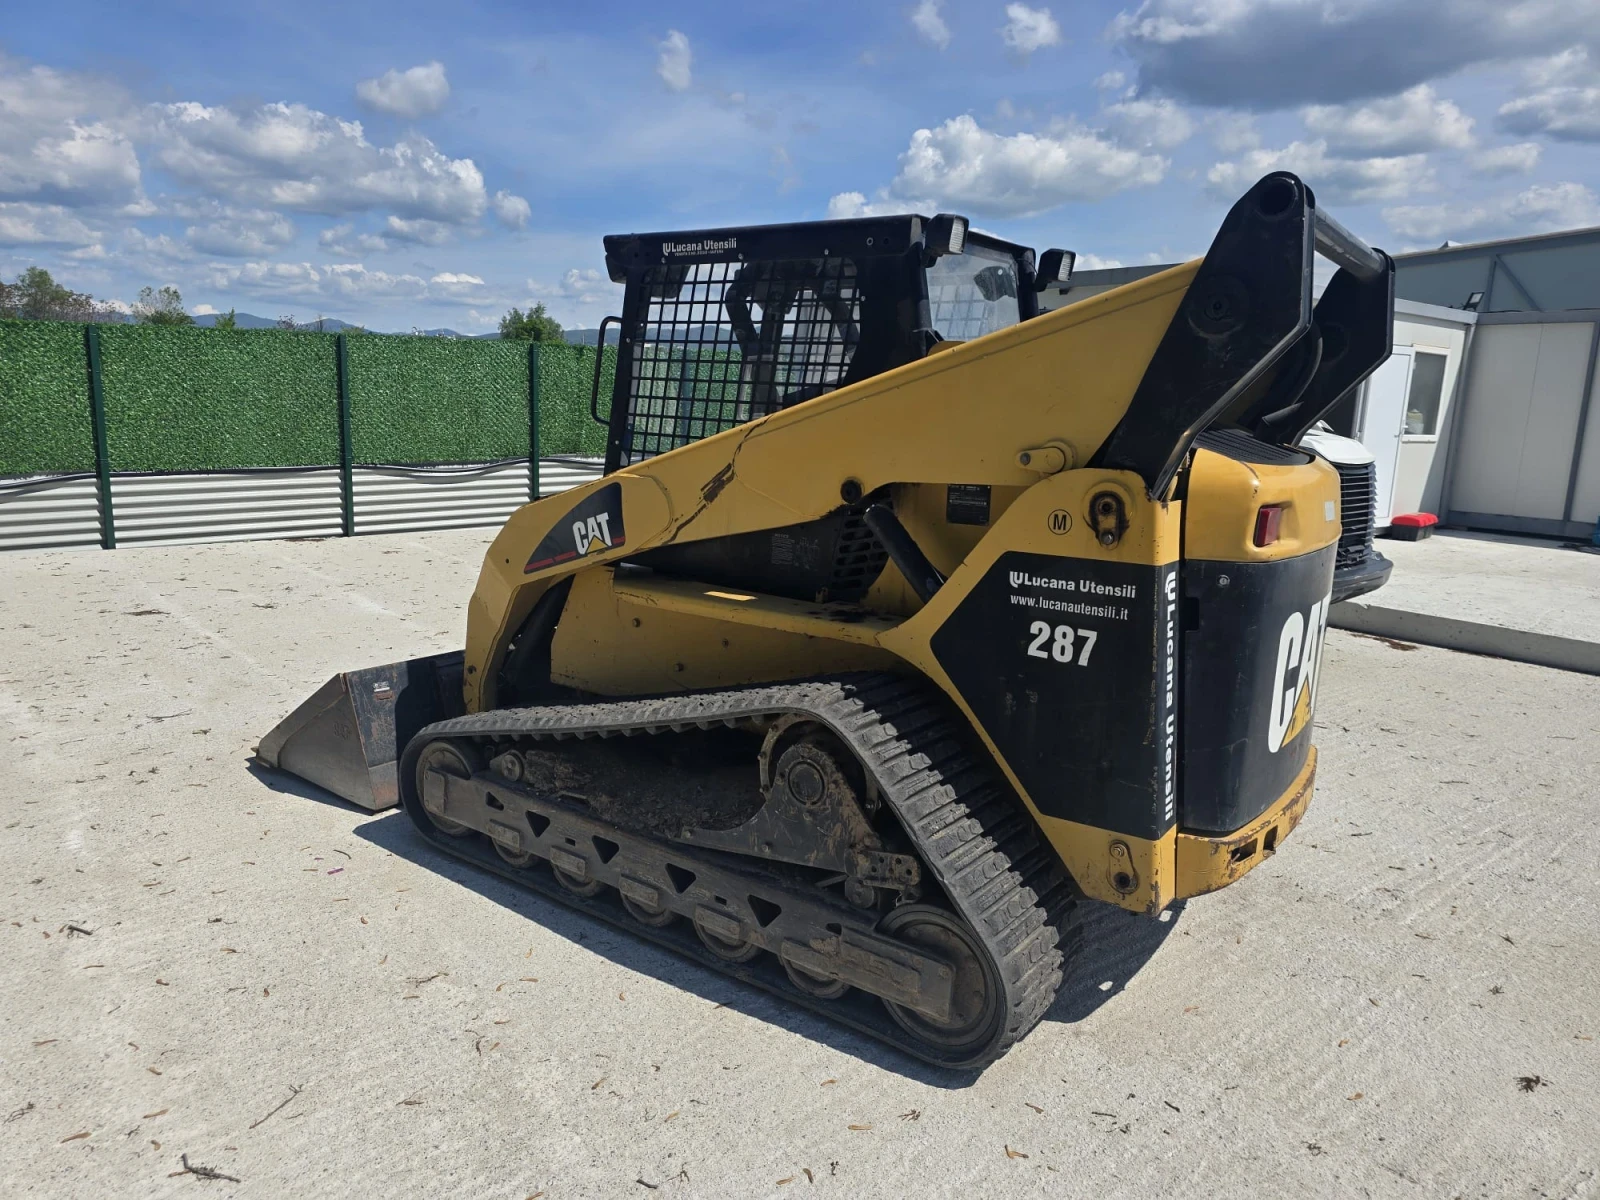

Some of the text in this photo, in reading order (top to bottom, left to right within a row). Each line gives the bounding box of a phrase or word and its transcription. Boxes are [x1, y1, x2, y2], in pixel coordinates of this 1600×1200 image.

[671, 242, 702, 253] Lucana
[703, 237, 737, 250] Utensili
[572, 512, 613, 555] CAT
[1053, 513, 1067, 531] M
[1024, 572, 1137, 599] Lucana Utensili
[1010, 594, 1129, 621] www.lucanautensili.it
[1027, 620, 1098, 667] 287
[1164, 609, 1176, 822] Lucana Utensili
